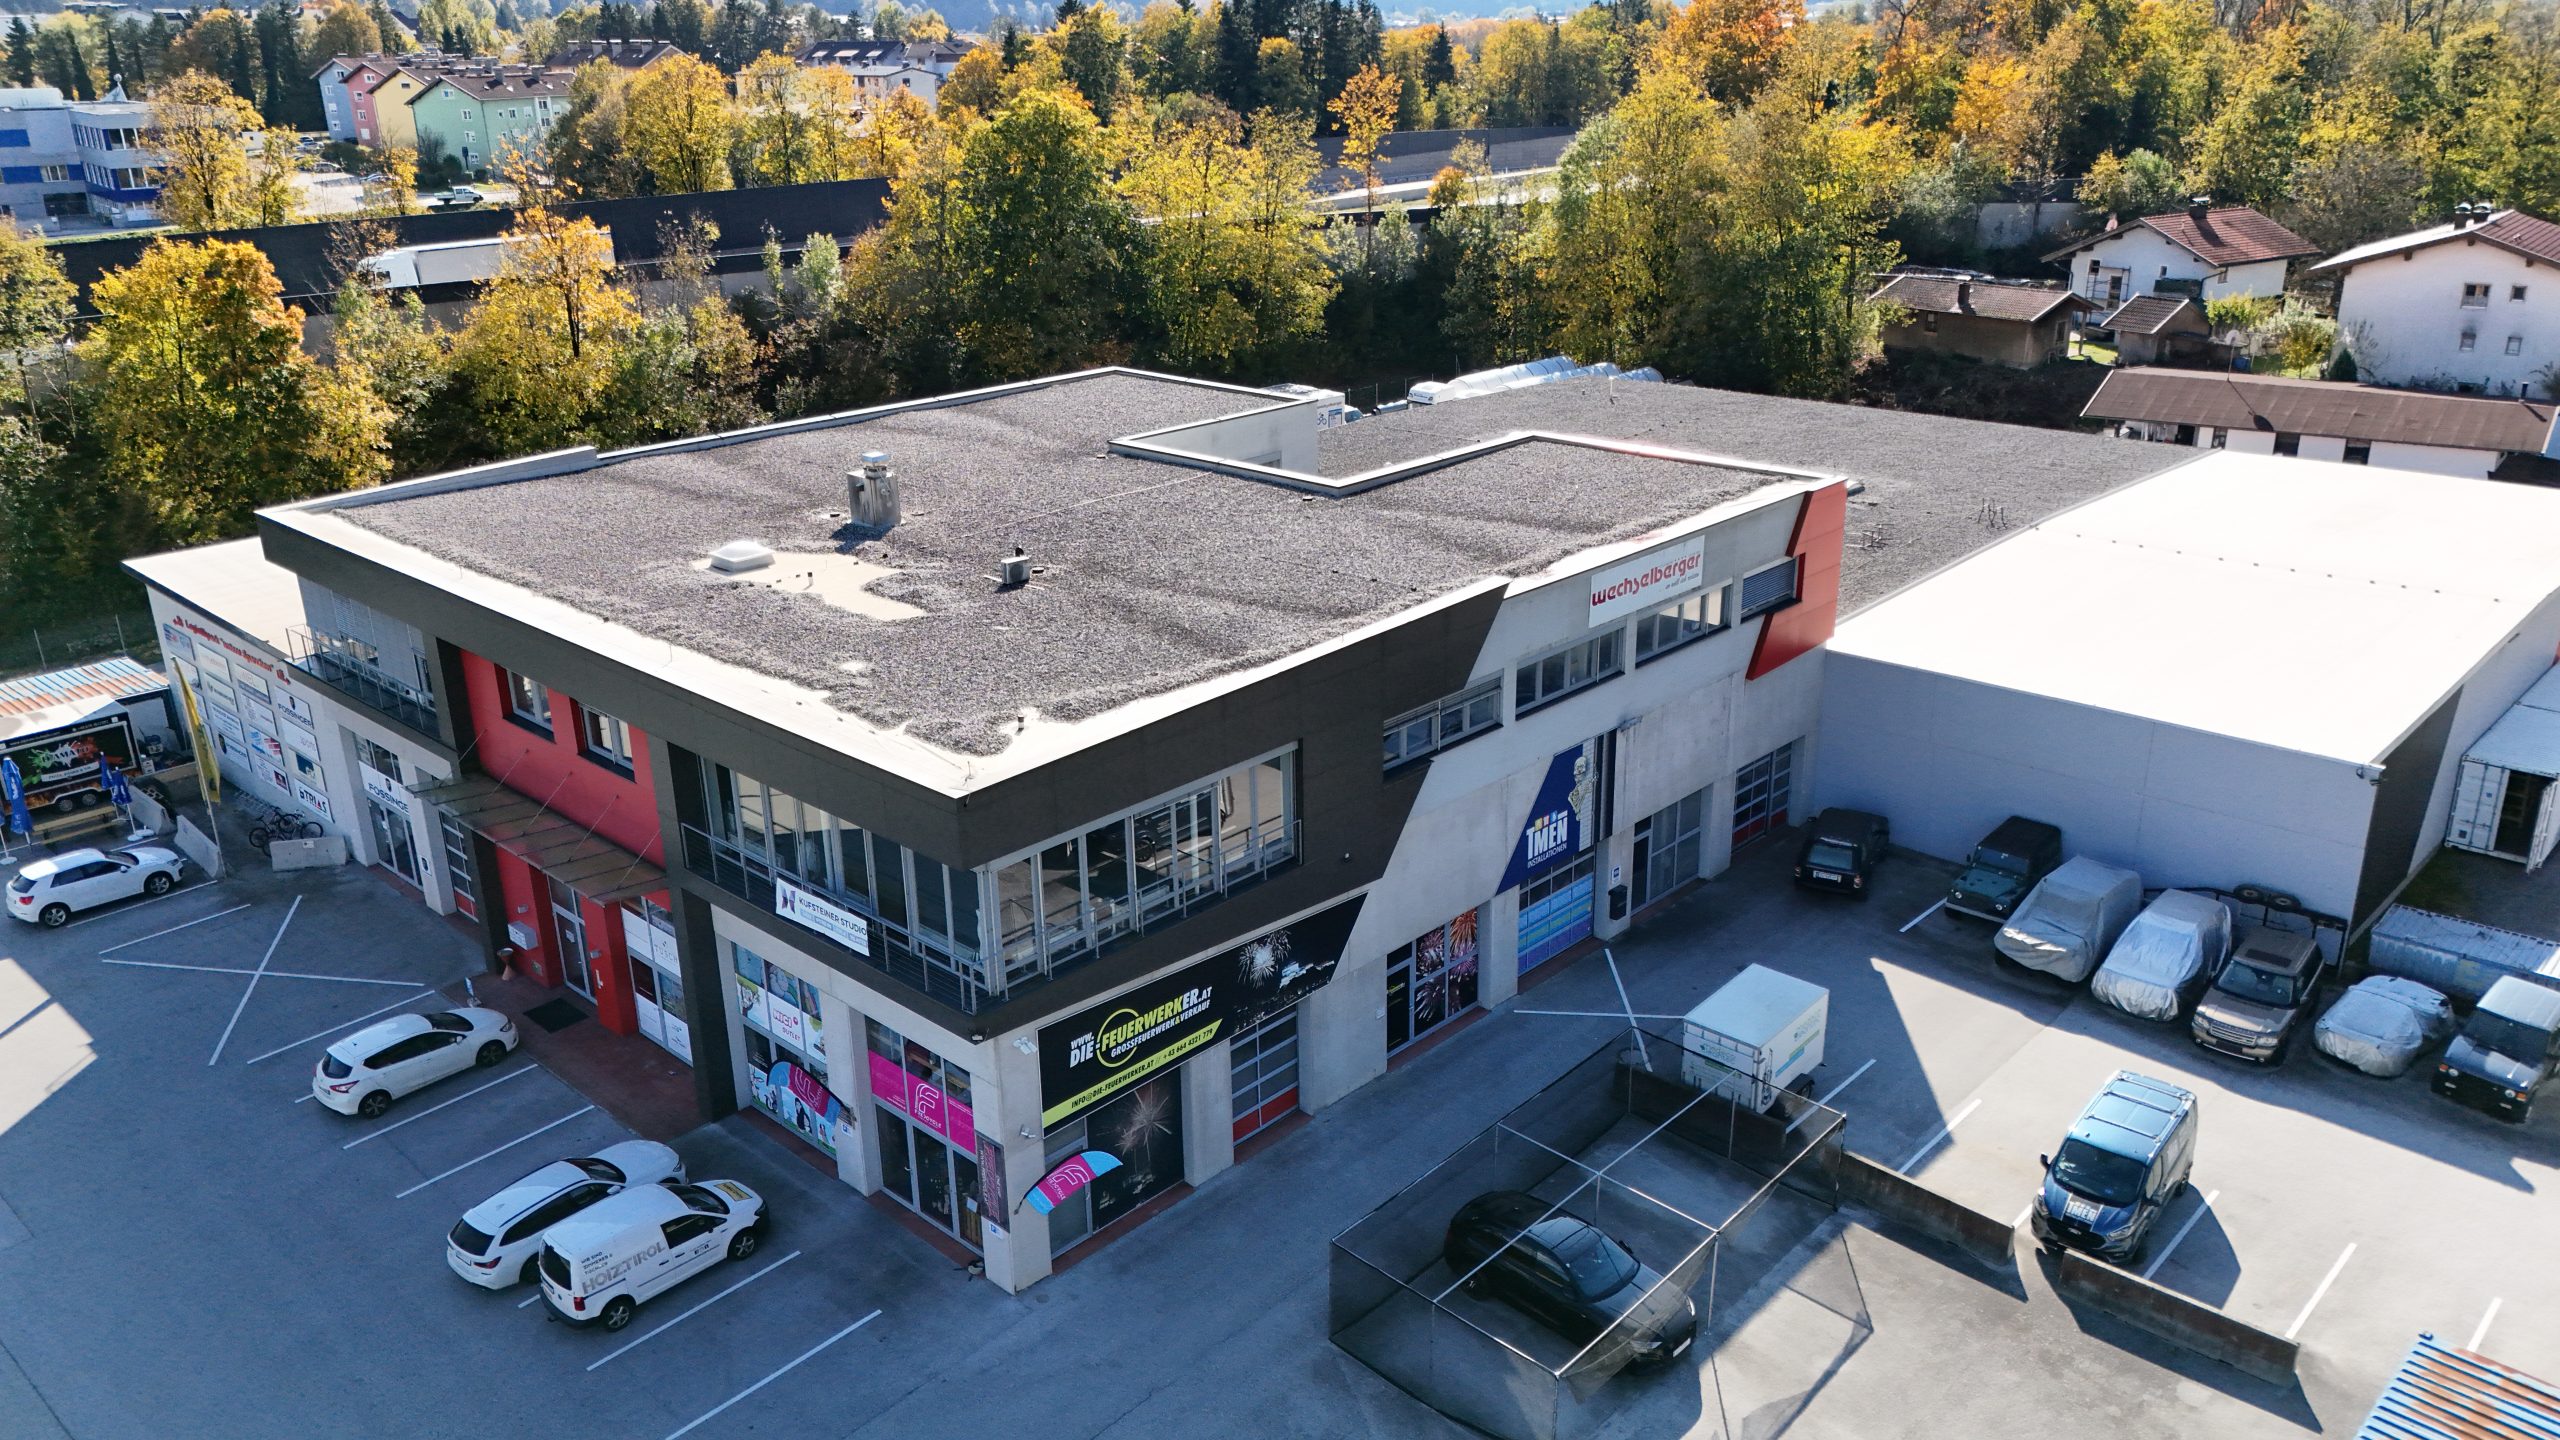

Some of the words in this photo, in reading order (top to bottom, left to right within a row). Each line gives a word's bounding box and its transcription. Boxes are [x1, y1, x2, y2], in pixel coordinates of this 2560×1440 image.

[1592, 553, 1701, 606] wechselberger
[278, 703, 313, 728] FOSSINGER
[368, 782, 409, 813] FOSSINGE
[1527, 842, 1568, 869] INSTALLATIONEN
[799, 896, 840, 923] KUFSTEINER
[840, 917, 867, 936] STUDIO
[772, 1008, 793, 1029] NICI
[782, 1026, 801, 1041] OUTLET
[1071, 1060, 1154, 1109] INFO@DIE-FEUERWERKER.AT
